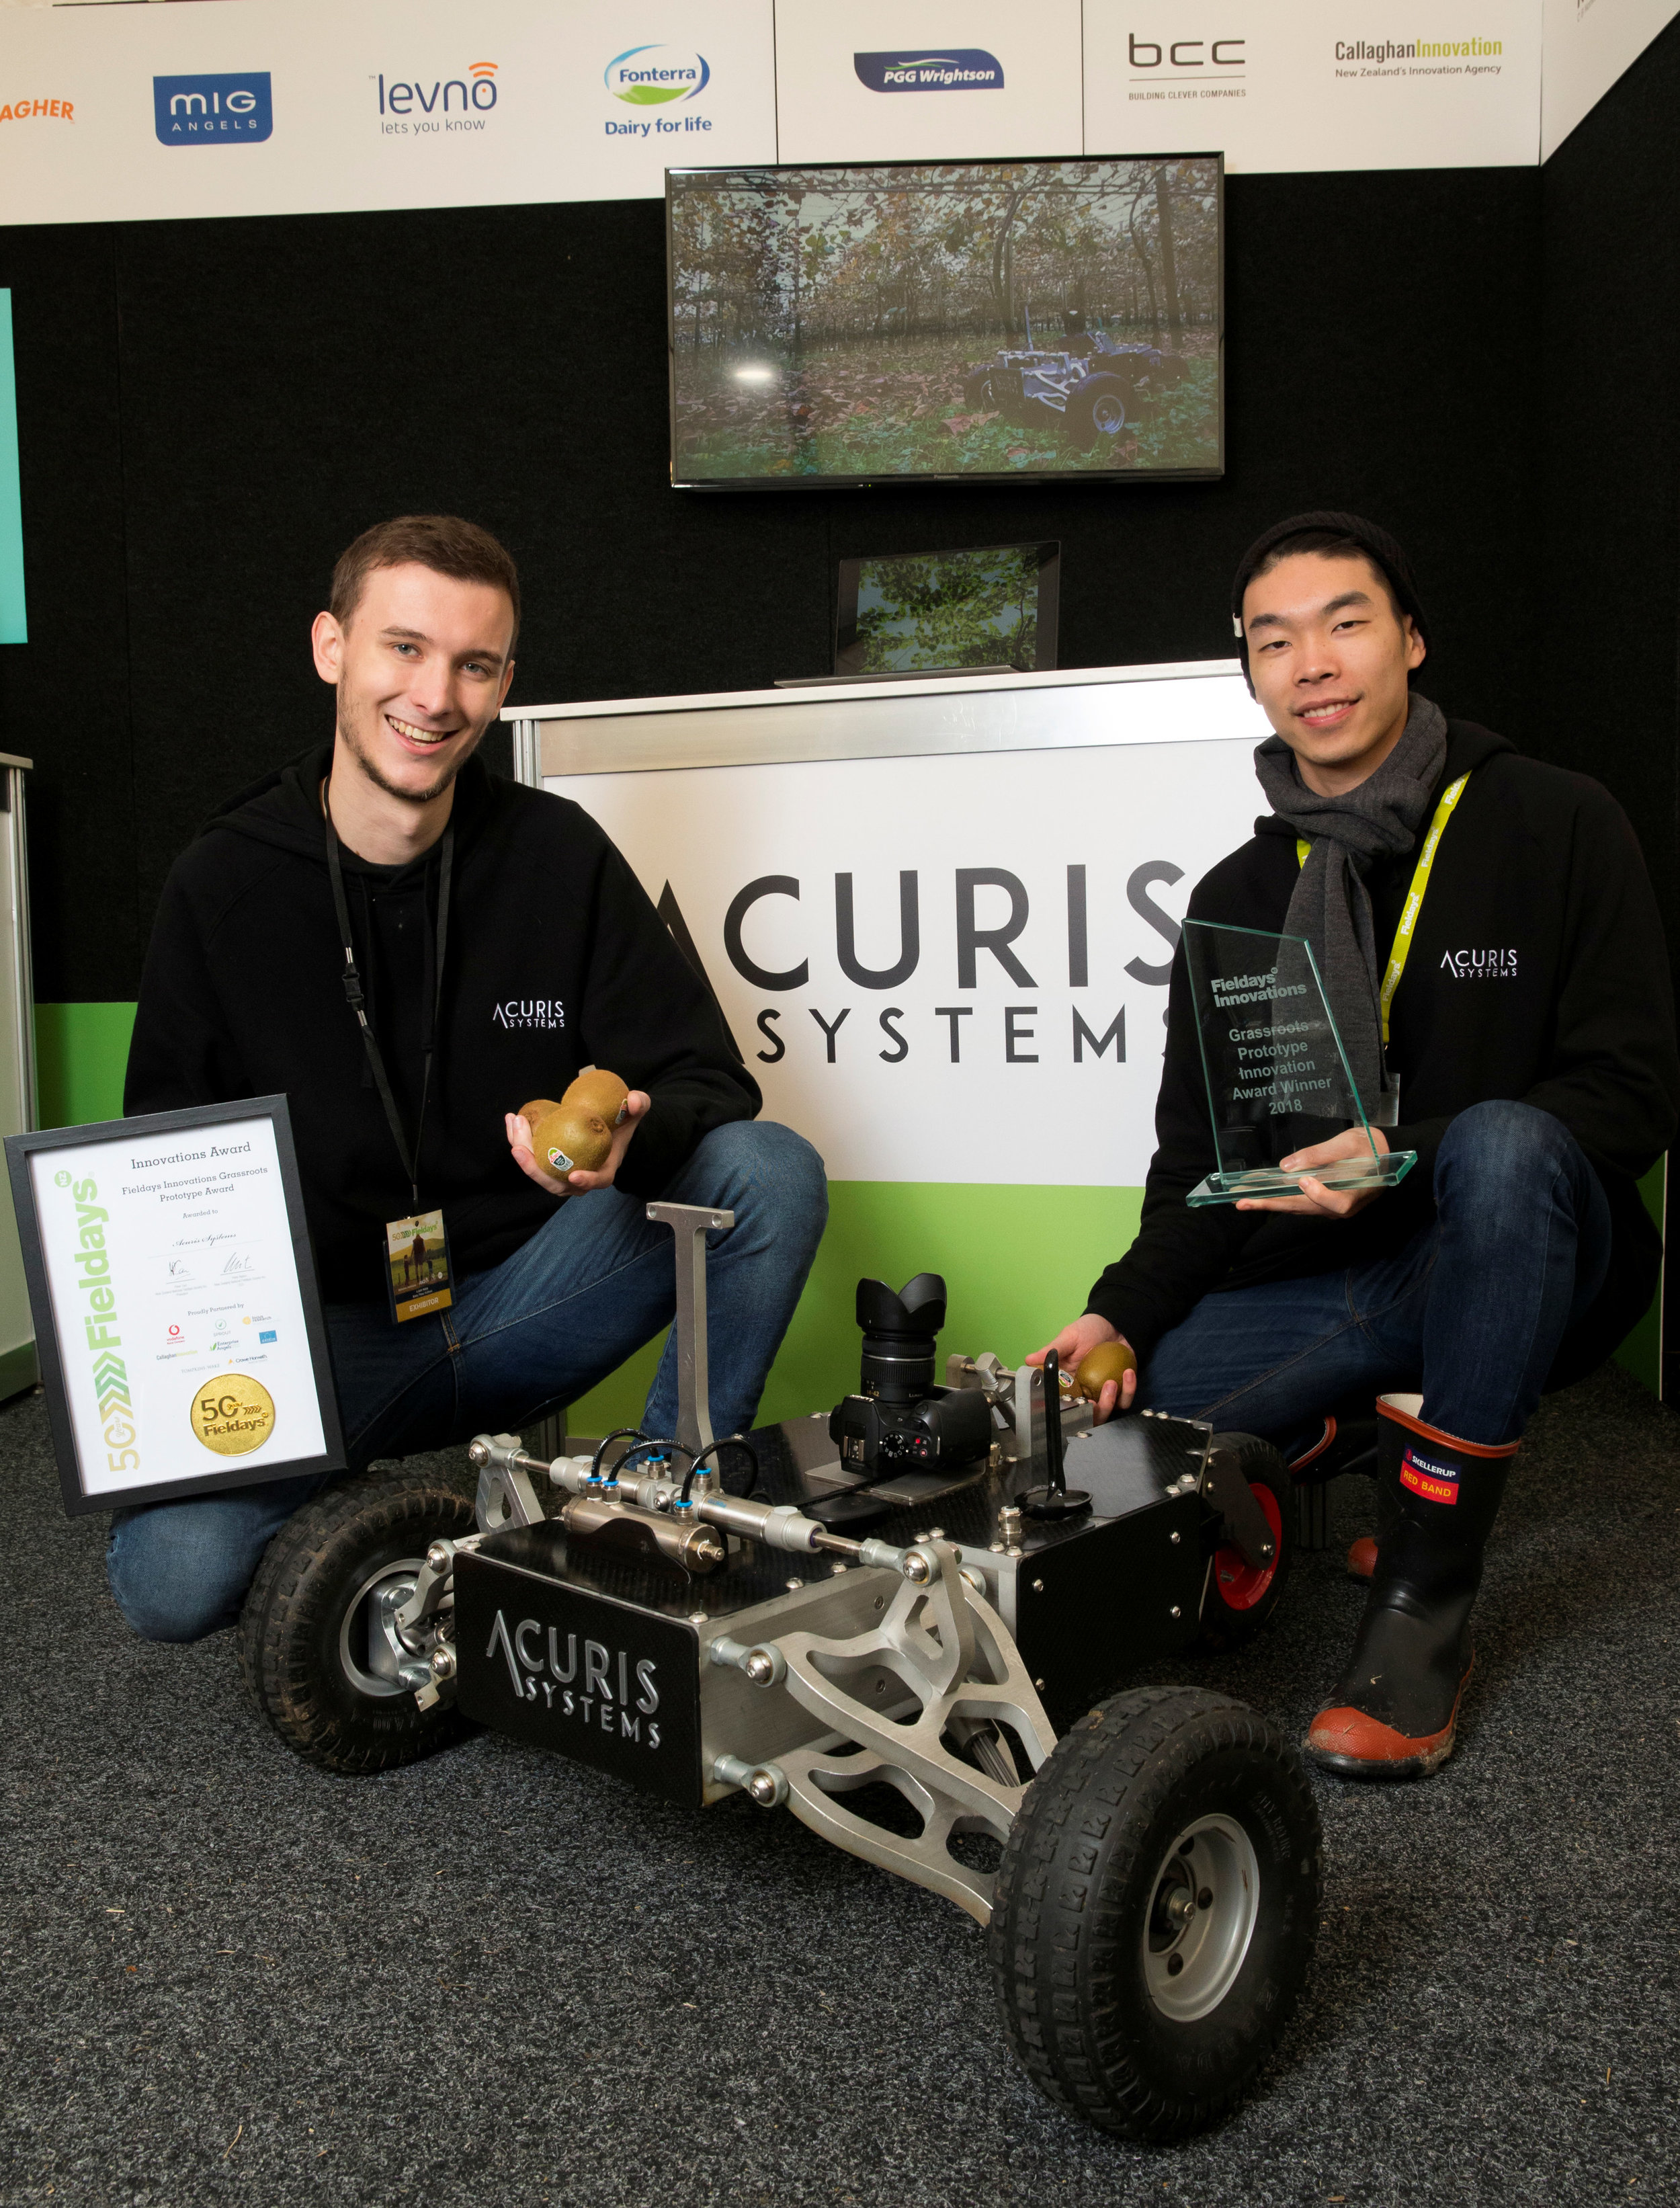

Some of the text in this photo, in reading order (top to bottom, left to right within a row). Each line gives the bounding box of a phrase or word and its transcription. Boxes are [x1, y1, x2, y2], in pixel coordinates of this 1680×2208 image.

[1129, 33, 1246, 67] bcc
[619, 67, 696, 83] Fonterra
[884, 68, 995, 85] PGG Wrightson
[1335, 65, 1502, 77] New Zealand's Innovation Agency
[378, 73, 498, 115] levno
[1129, 89, 1246, 100] BUILDING CLEVER COMPANIES
[171, 119, 257, 132] ANGELS
[382, 118, 486, 136] lets you know
[605, 116, 712, 137] Dairy for life
[1421, 827, 1439, 868] Fieldays
[1401, 894, 1420, 936] Fieldays
[1440, 948, 1518, 979] ACURIS
[1459, 967, 1517, 978] SYSTEMS
[1211, 972, 1276, 993] Fieldays
[1382, 960, 1401, 1002] Fieldays
[1214, 983, 1307, 1008] Innovations
[493, 999, 564, 1029] ACURIS
[509, 1018, 565, 1029] SYSTEMS
[757, 1004, 1169, 1065] SYSTEM
[1228, 1020, 1310, 1042] Grassroots
[1238, 1040, 1308, 1061] Prototype
[1238, 1059, 1316, 1080] Innovation
[1232, 1077, 1332, 1101] Award Winner
[1269, 1098, 1303, 1116] 2018
[131, 1141, 251, 1170] Innovations Award
[122, 1166, 268, 1195] Fieldays Innovations Grassroots
[160, 1184, 235, 1202] Prototype Award
[183, 1209, 211, 1219] Awarded
[411, 1224, 438, 1237] Fieldays
[72, 1178, 122, 1351] Fieldays
[187, 1307, 209, 1317] Proudly
[210, 1303, 236, 1313] Partnered
[409, 1297, 439, 1313] EXHIBITOR
[203, 1418, 266, 1437] Fieldays
[1412, 1455, 1456, 1477] SKELLERUP
[1403, 1469, 1452, 1497] RED BAND
[486, 1609, 660, 1715] ACURIS
[526, 1676, 661, 1749] SYSTEMS
